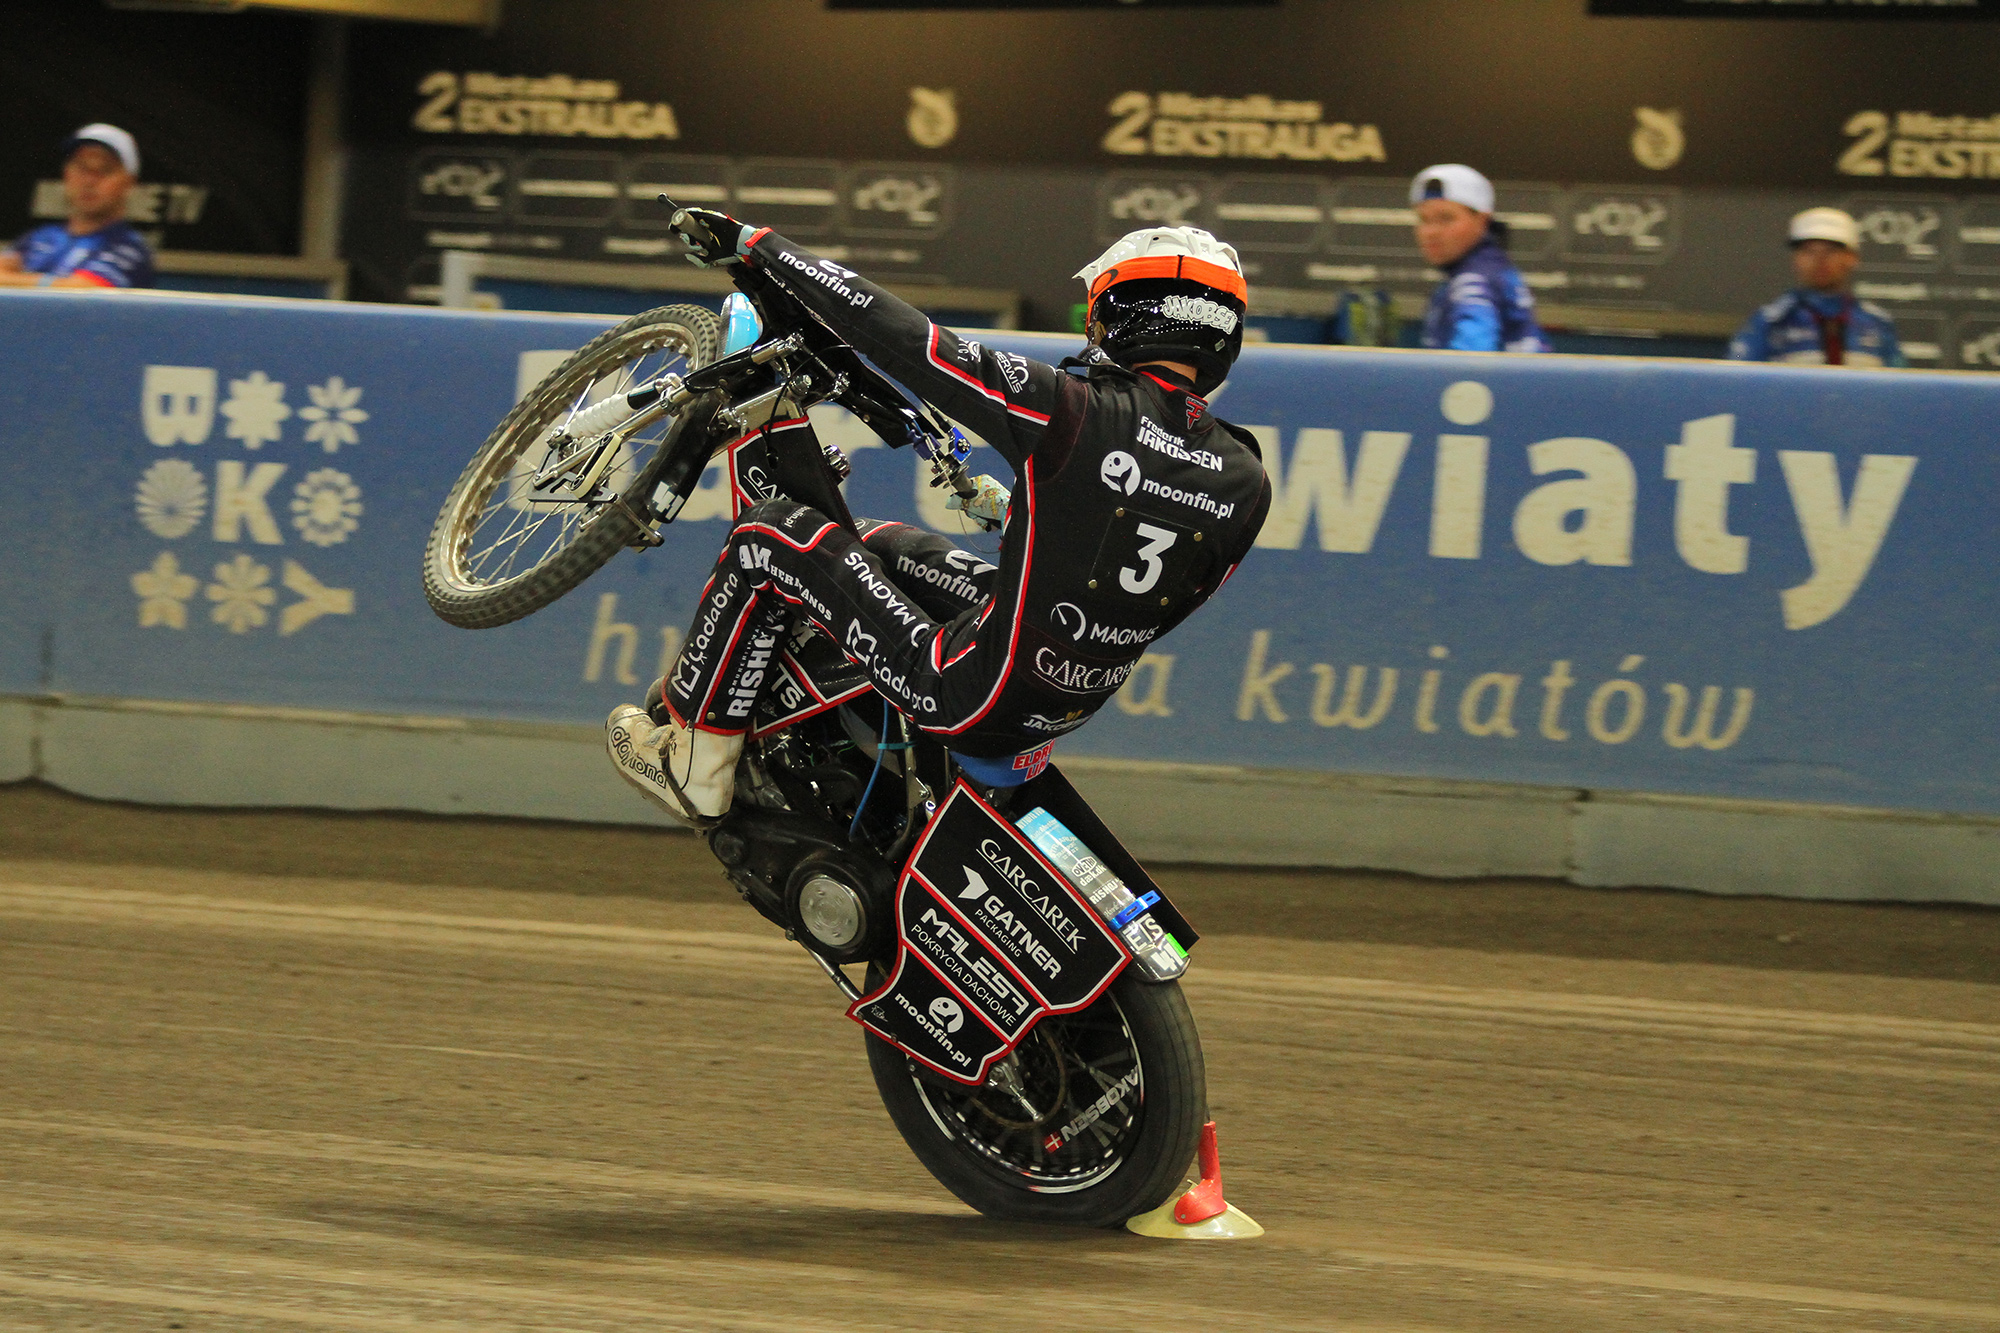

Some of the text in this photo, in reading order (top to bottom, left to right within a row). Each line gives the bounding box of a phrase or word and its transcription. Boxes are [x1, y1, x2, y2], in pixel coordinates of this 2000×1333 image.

[413, 70, 458, 135] 2
[1103, 90, 1152, 157] 2
[1838, 110, 1887, 177] 2
[778, 251, 874, 309] moonfin.pl
[1140, 415, 1185, 448] Frederik
[1142, 477, 1235, 520] moonfin.pl
[1205, 378, 1919, 631] wiaty
[844, 551, 917, 626] MAGNUS
[896, 555, 989, 608] moonfin.
[1118, 522, 1178, 595] 3
[1035, 645, 1139, 689] GARCAR
[1090, 622, 1160, 646] MAGNUS
[770, 661, 806, 710] TS
[1235, 630, 1755, 752] kwiatów
[609, 726, 668, 790] daytona
[979, 838, 1087, 952] GARCAREK
[974, 908, 1023, 958] PACKAGING
[983, 895, 1063, 981] GATNER
[910, 924, 1017, 1027] POKRYCIA DACHOWE
[894, 993, 972, 1068] moonfin.pl
[1060, 1064, 1139, 1142] AKOBSEN
